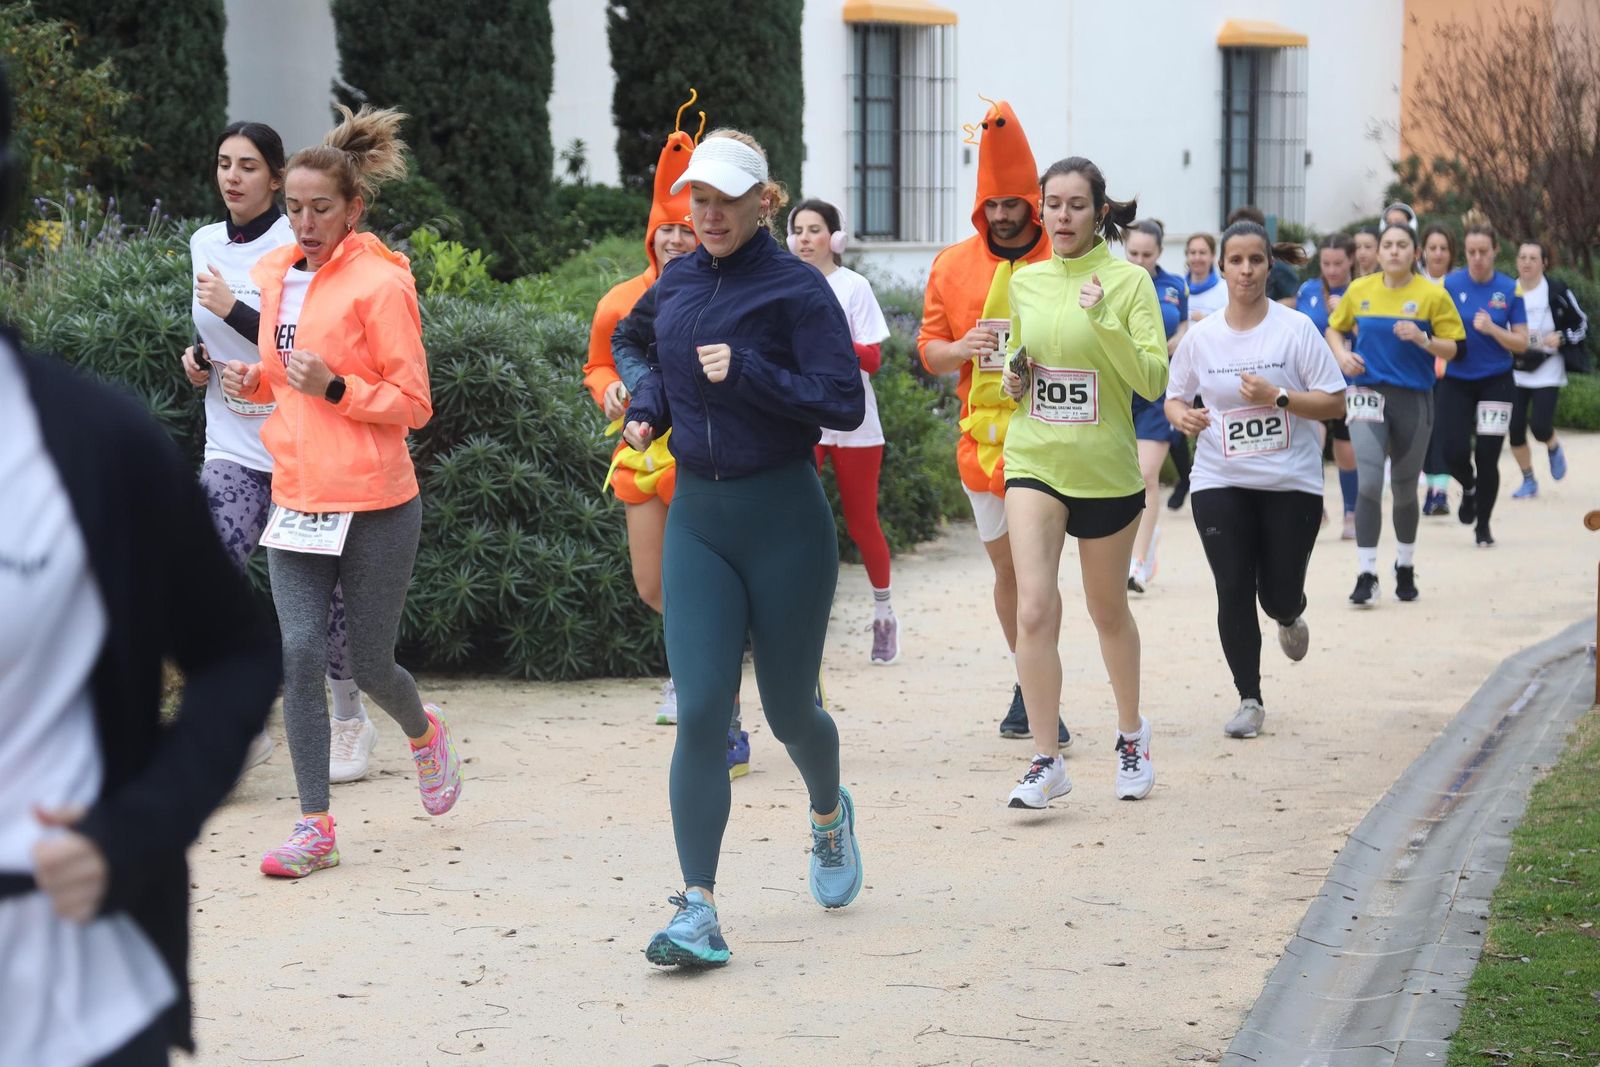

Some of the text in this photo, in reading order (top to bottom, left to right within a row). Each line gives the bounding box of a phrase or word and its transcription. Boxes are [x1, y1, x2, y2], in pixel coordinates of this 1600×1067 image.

[274, 324, 297, 350] ER
[1036, 378, 1088, 405] 205
[1228, 416, 1282, 441] 202
